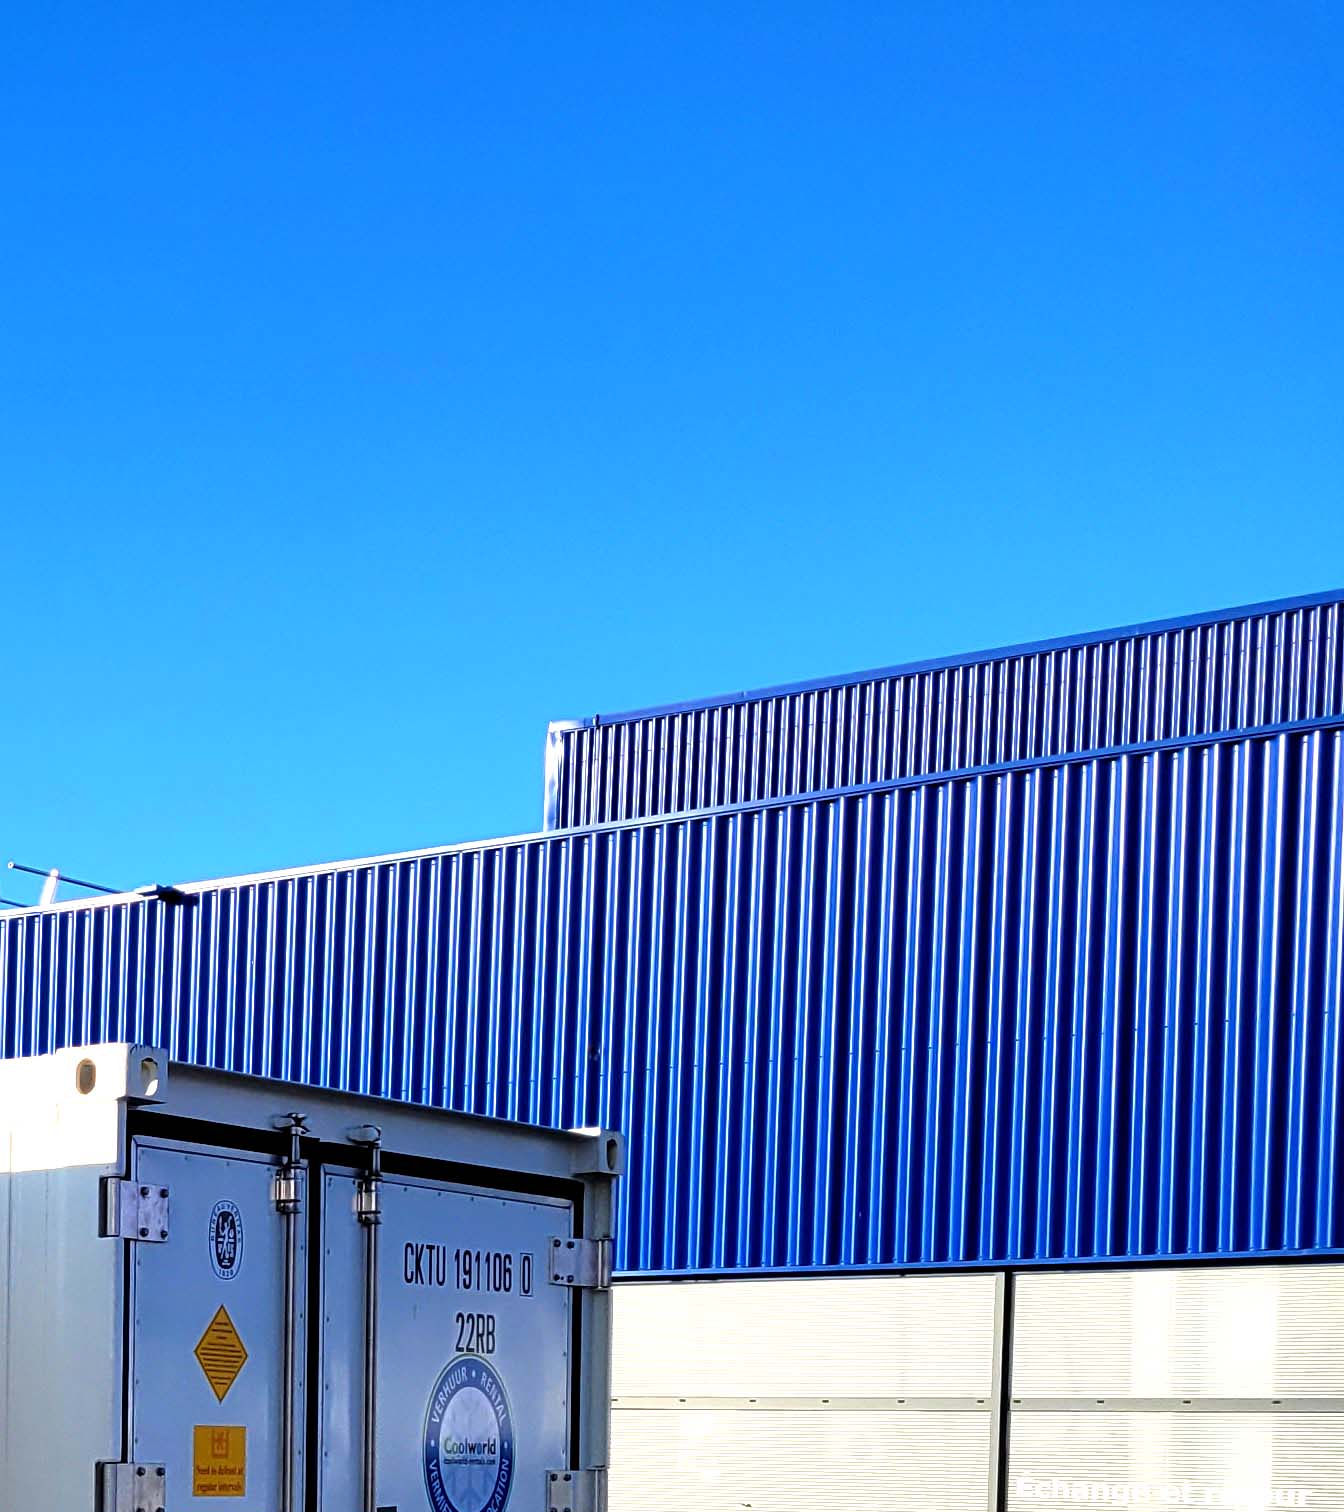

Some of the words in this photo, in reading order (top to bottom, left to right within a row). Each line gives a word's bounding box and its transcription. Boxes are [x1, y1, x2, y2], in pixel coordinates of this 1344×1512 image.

[404, 1243, 446, 1286] CKTU
[454, 1249, 512, 1292] 191106
[521, 1255, 531, 1295] 0
[455, 1312, 496, 1353] 22RB
[431, 1366, 468, 1423] VERHUUR
[480, 1371, 506, 1426] RENTAL
[444, 1437, 496, 1455] Coolworld
